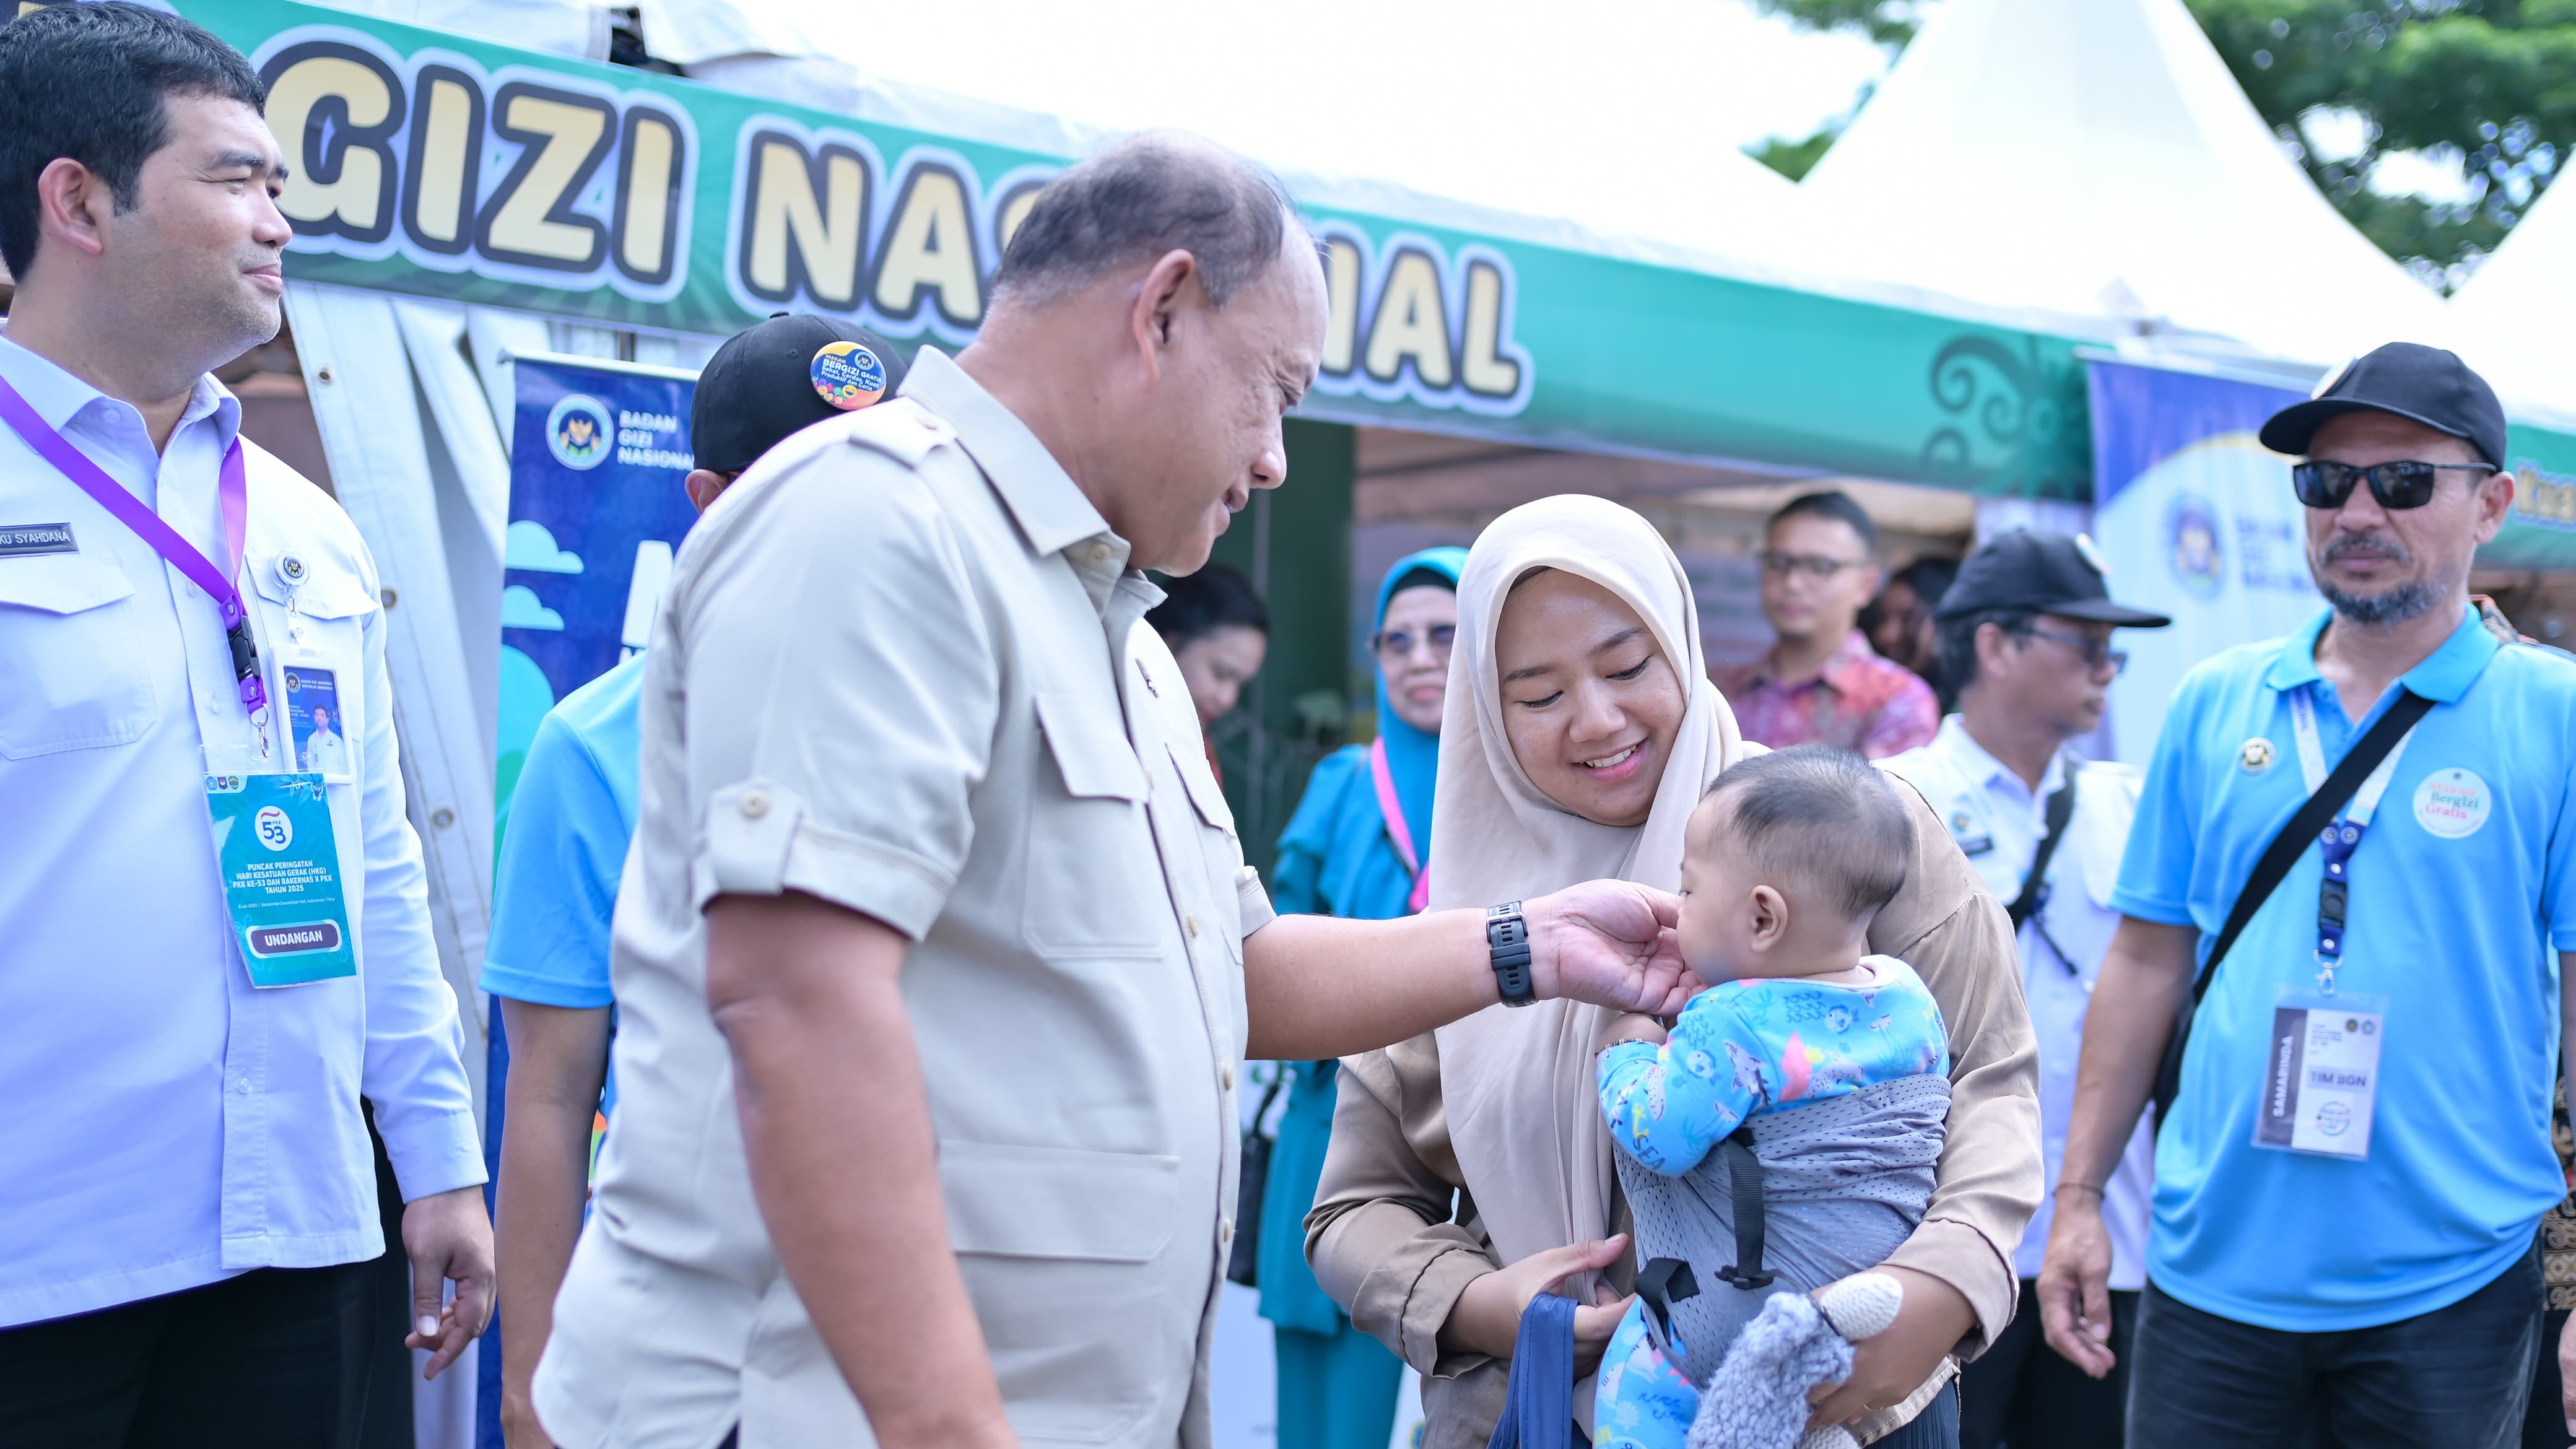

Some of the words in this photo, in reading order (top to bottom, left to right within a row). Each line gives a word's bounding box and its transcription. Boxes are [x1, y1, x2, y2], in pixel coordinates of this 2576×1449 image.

[253, 41, 685, 285] GIZI
[739, 131, 1521, 399] NAAL
[825, 354, 846, 363] MAKAN
[822, 359, 859, 376] BERGIZI
[821, 370, 846, 383] Produktif
[847, 378, 858, 386] dan
[858, 383, 872, 391] Ceria
[822, 365, 840, 375] Sehat,
[841, 372, 864, 383] Cerdas,
[865, 380, 880, 388] Kuat
[619, 409, 677, 433] BADAN
[618, 428, 653, 447] GIZI
[617, 446, 695, 471] NASIONA
[15, 531, 71, 544] SYAHDANA
[262, 821, 286, 844] 53
[248, 863, 274, 871] PUNCAK
[275, 860, 313, 869] PERINGATAN
[253, 870, 286, 879] KESATUAN
[287, 869, 307, 877] GERAK
[308, 867, 326, 876] (HKG)
[265, 886, 287, 894] TAHUN
[289, 884, 304, 892] 2025
[282, 876, 313, 886] RAKERNAS
[264, 930, 323, 947] UNDANGAN
[2272, 1035, 2294, 1118] SAMARINDA
[2311, 1071, 2334, 1083] TIM
[2338, 1073, 2367, 1087] BGN
